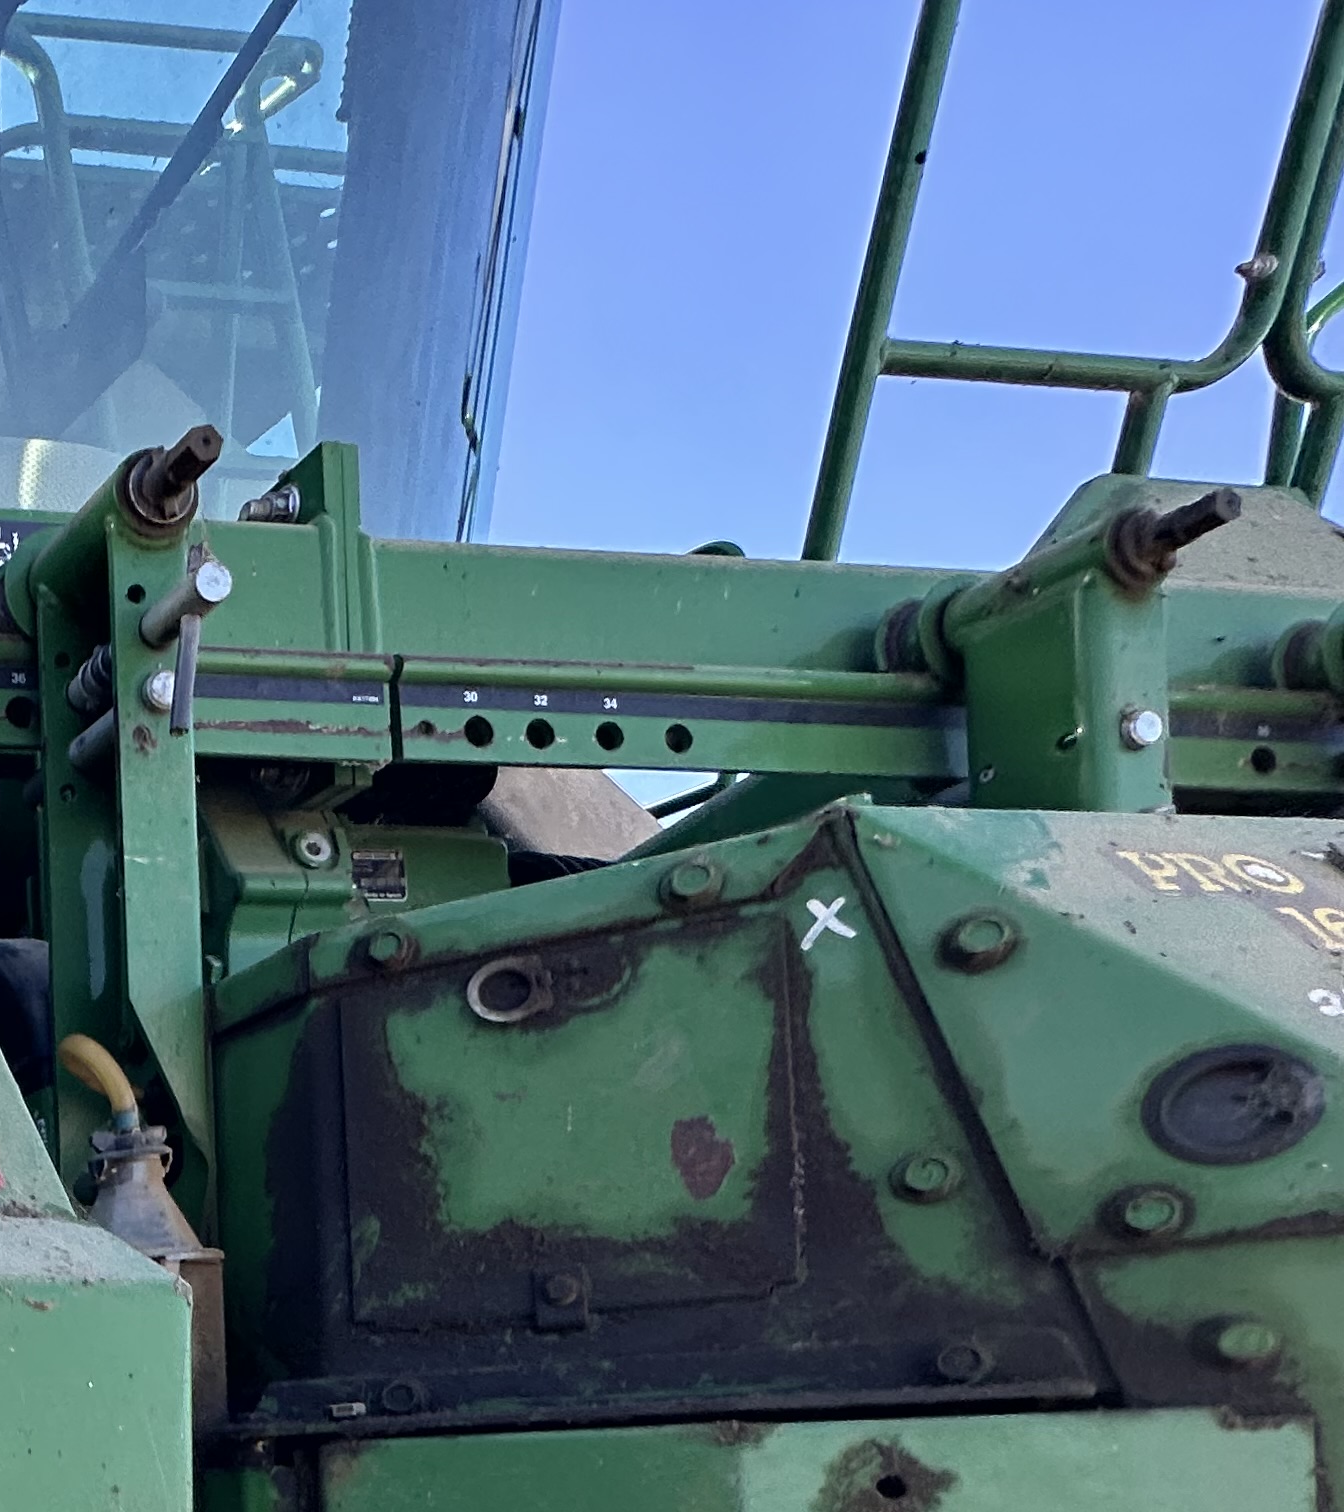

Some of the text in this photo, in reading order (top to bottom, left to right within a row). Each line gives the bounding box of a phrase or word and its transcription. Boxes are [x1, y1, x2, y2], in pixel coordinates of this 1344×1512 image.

[463, 691, 618, 710] 30 32 34
[1115, 850, 1306, 895] PRO
